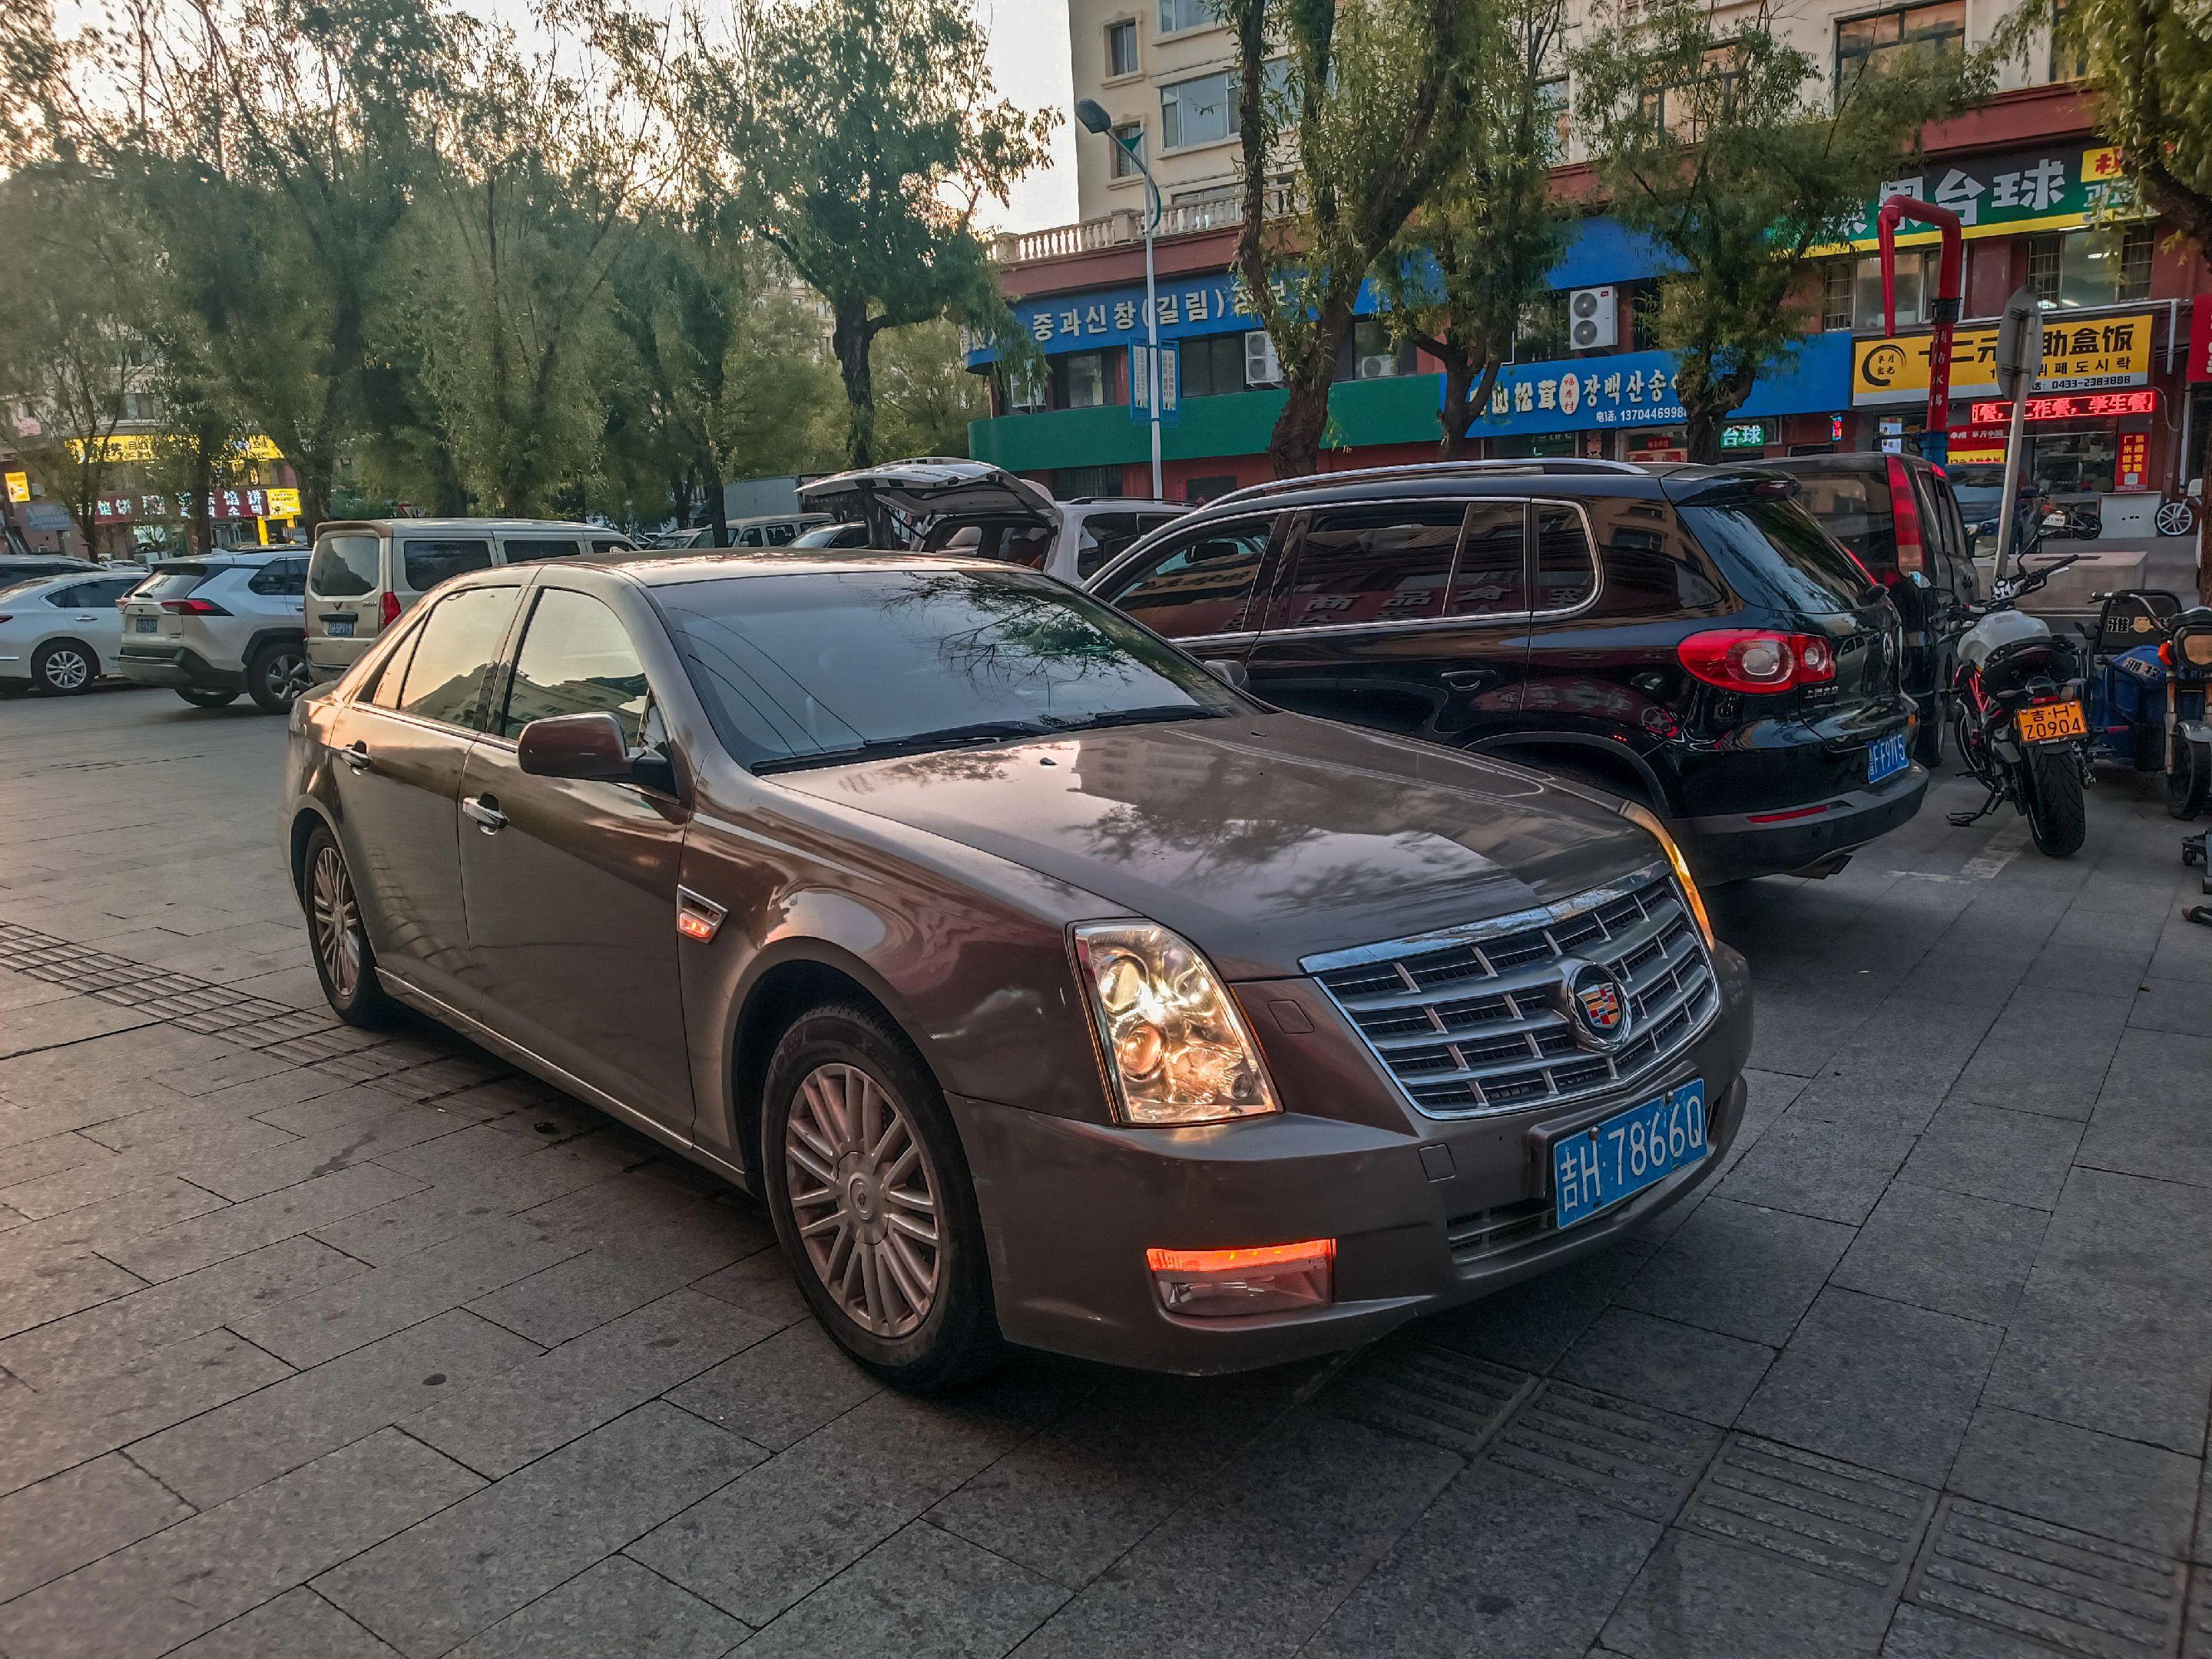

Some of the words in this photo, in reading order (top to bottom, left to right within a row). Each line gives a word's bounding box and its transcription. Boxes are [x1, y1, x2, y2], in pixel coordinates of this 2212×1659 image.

[1918, 323, 2135, 367] 十二元助盒饭
[1470, 379, 1558, 415] 山松茸
[1723, 427, 1762, 446] 台球
[2024, 717, 2081, 740] Z0904
